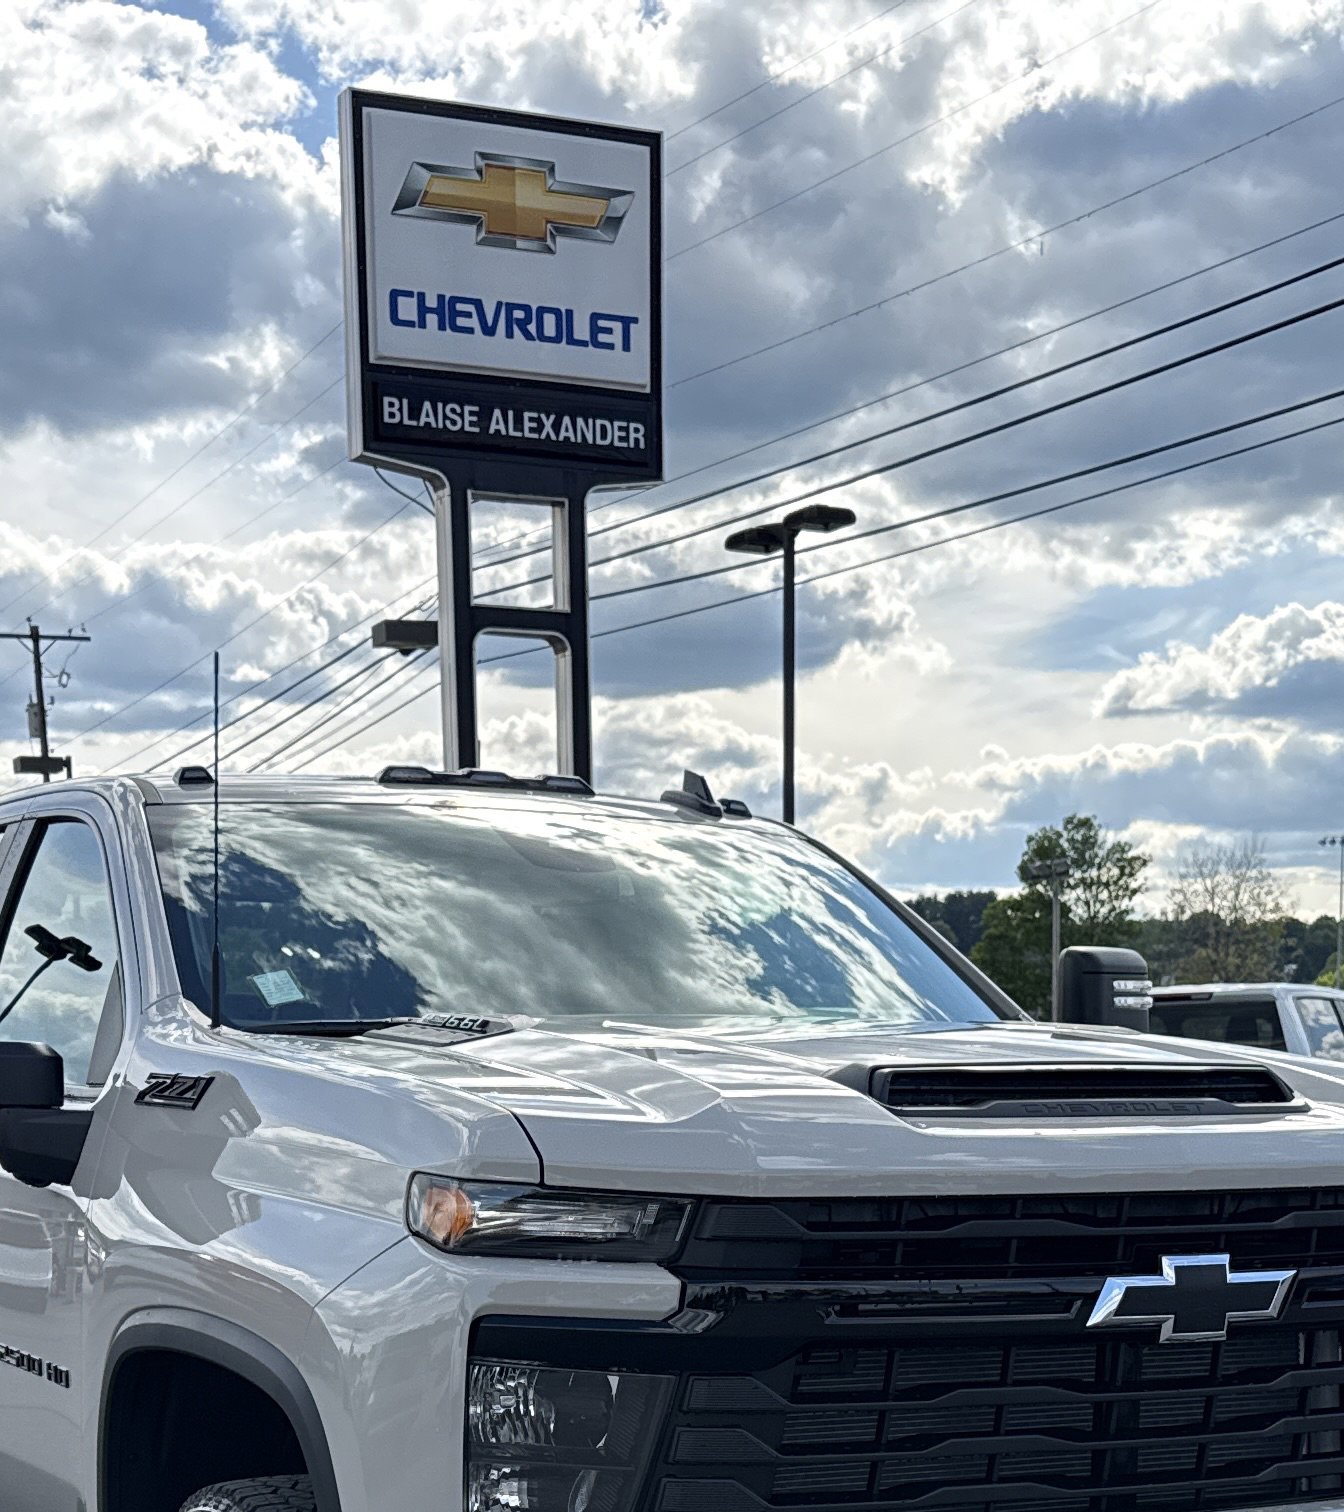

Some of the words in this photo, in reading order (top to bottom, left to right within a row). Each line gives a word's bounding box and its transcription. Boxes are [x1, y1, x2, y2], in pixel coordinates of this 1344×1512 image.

[389, 288, 639, 352] CHEVROLET
[382, 396, 480, 433] BLAISE
[489, 408, 646, 450] ALEXANDER
[1022, 1102, 1207, 1115] CHEVROLET
